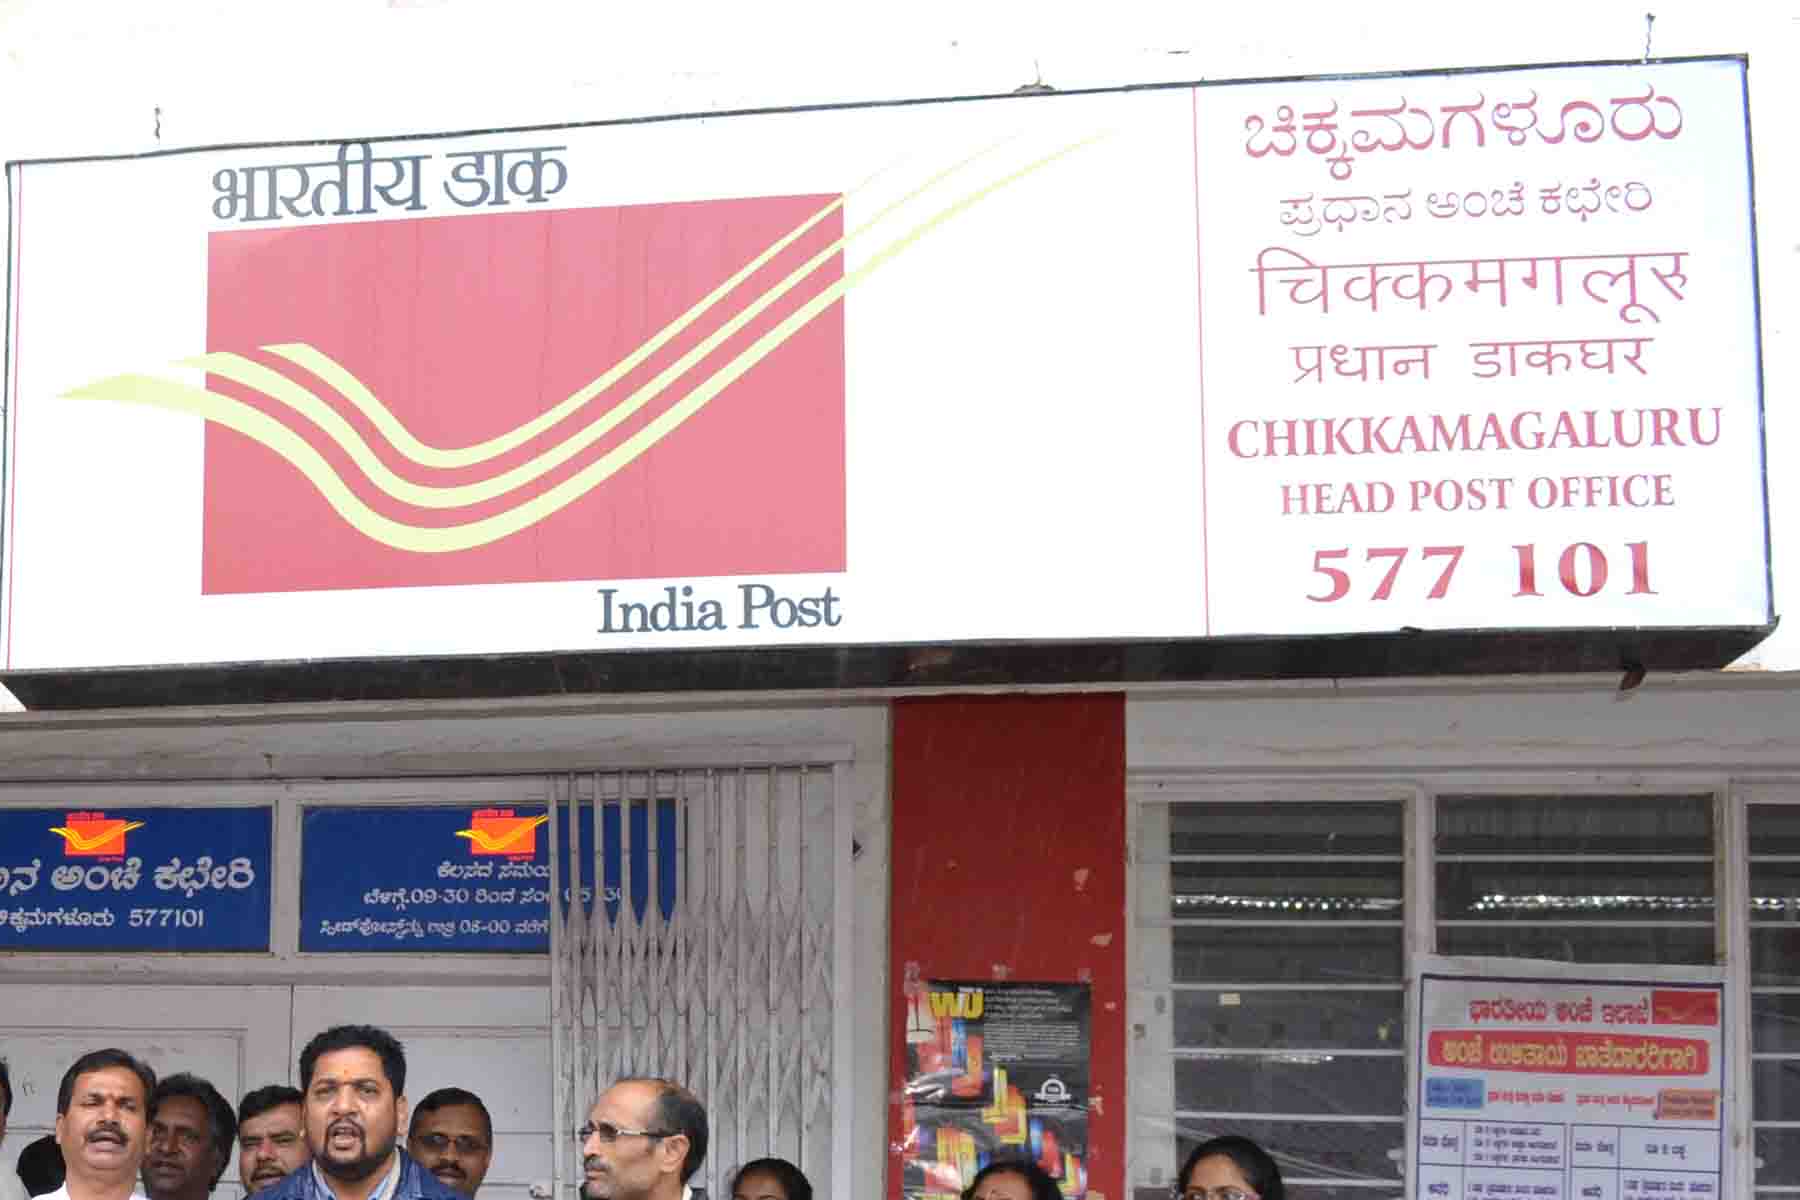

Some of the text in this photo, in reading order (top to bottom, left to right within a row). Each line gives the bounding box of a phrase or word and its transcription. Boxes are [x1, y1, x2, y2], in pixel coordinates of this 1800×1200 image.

[1243, 82, 1683, 180] ಚಿಕ್ಕಮಗಳೂರು
[211, 140, 568, 222] भारतीय डाक
[1279, 177, 1653, 237] ಪ್ರಧಾನ ಅಂಚೆ ಕಛೇರಿ
[1288, 337, 1654, 384] प्रधान डाकघर
[1226, 407, 1722, 458] CHIKKAMAGALURU
[1280, 473, 1675, 516] HEAD POST OFFICE
[1306, 540, 1660, 603] 577 101
[599, 583, 843, 634] India Post
[51, 856, 143, 891] ಅಂಚೆ
[153, 856, 256, 898] ಕಛೇರಿ
[128, 908, 205, 929] 577101
